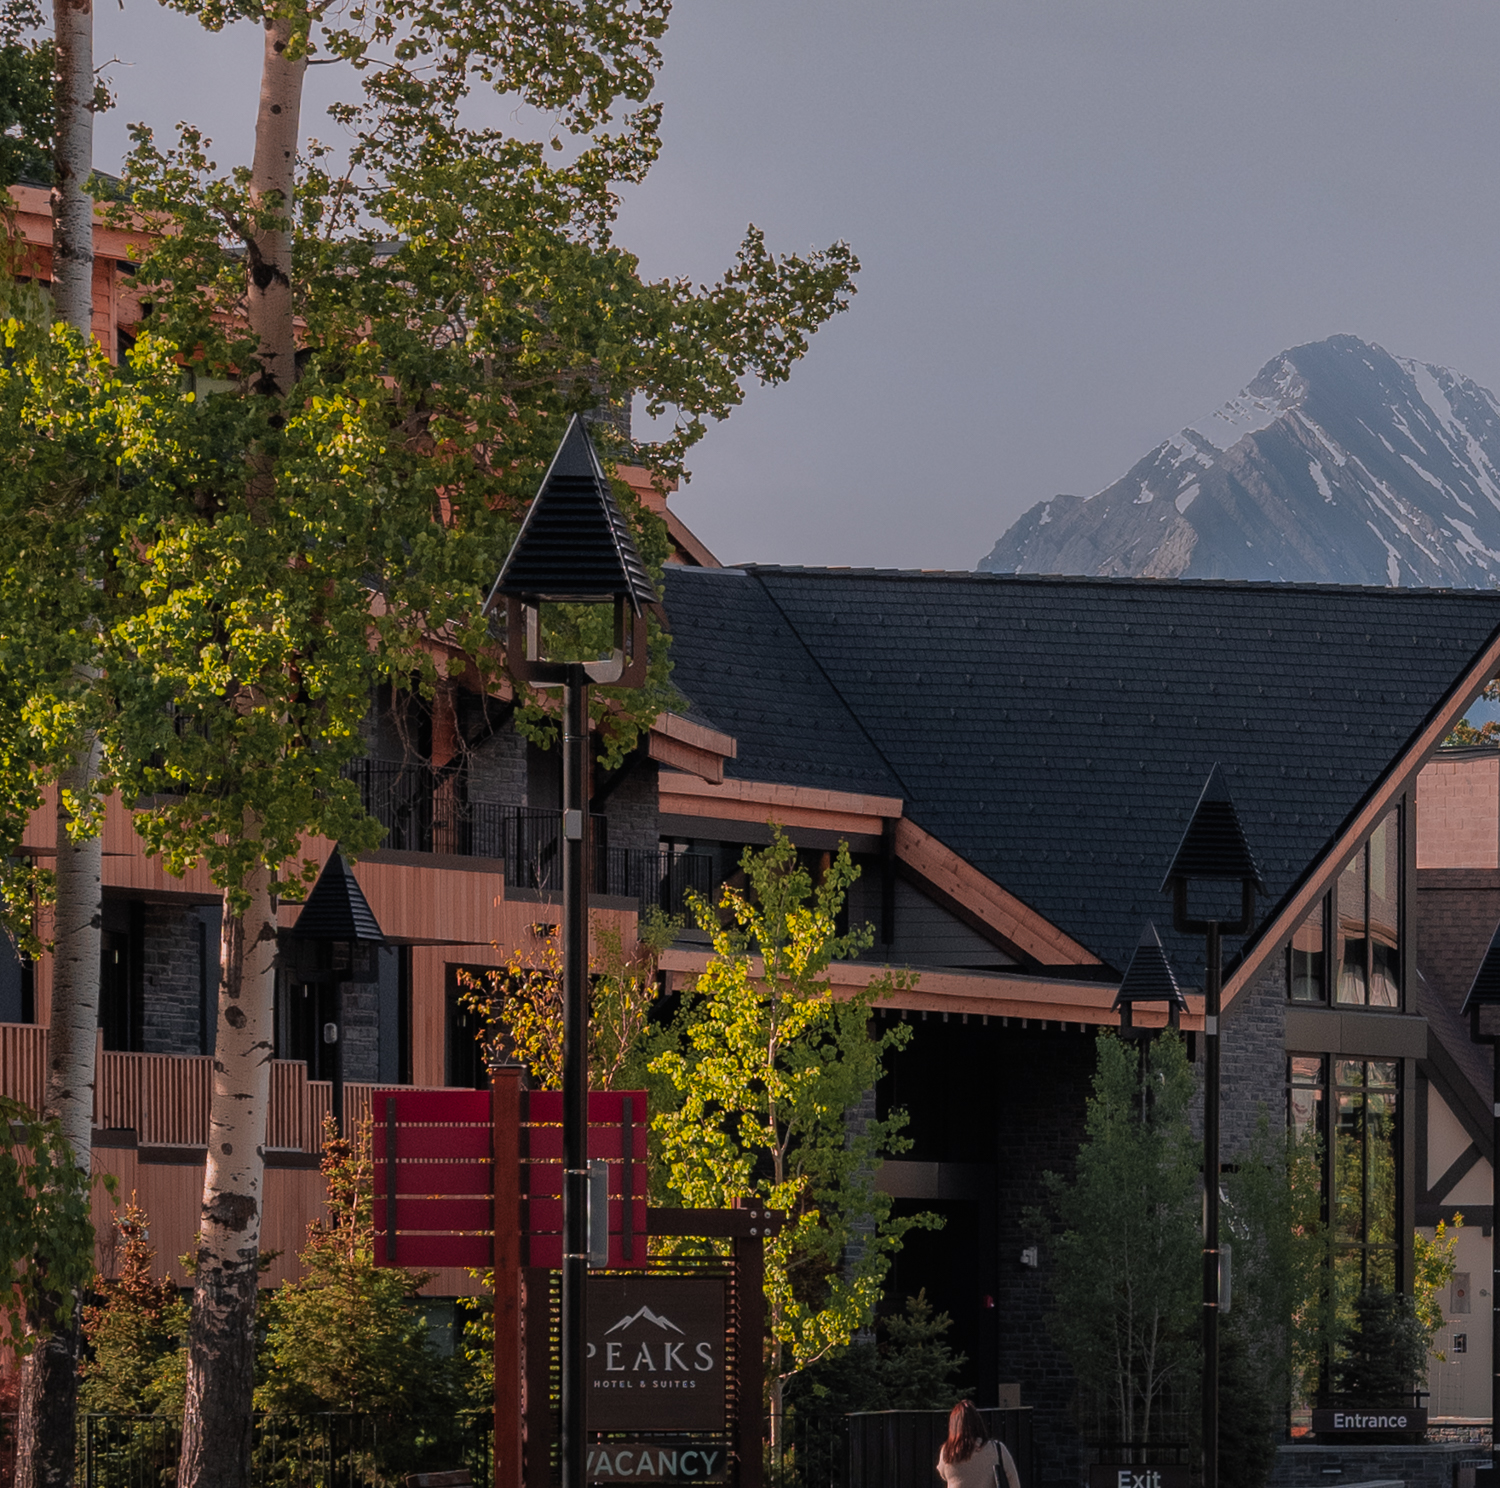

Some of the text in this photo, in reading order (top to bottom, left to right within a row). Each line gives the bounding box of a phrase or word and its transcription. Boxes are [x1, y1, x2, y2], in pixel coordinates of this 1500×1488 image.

[594, 1380, 697, 1388] HOTEL & SUITES
[1333, 1413, 1407, 1429] Entrance
